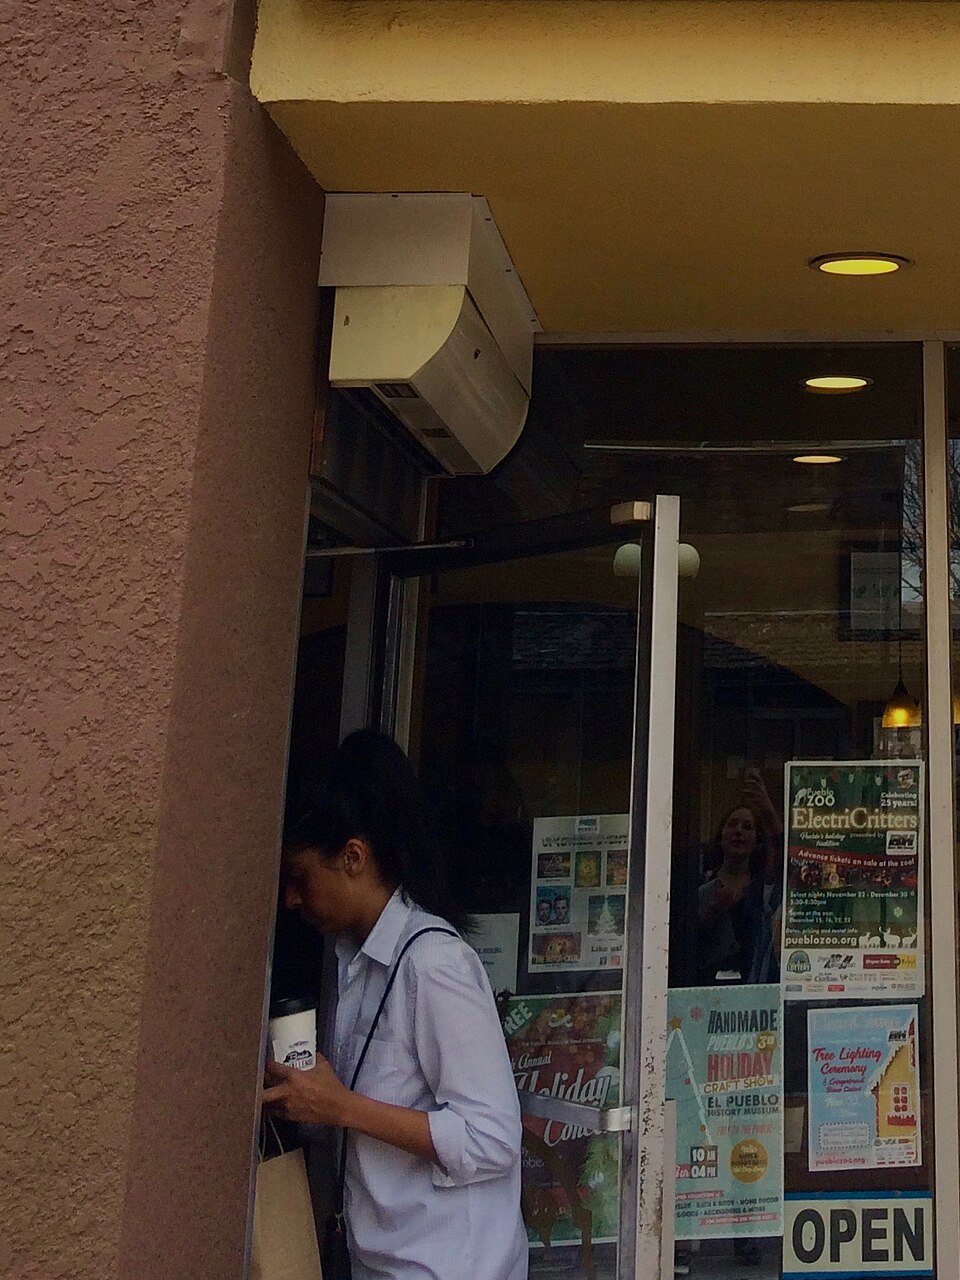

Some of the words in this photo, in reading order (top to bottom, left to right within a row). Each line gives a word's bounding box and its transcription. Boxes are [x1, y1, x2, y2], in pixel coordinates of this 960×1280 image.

[807, 788, 834, 797] Pueblo
[807, 796, 835, 807] ZOO
[792, 807, 918, 829] ElectriCritters
[798, 850, 829, 861] Advance
[829, 855, 851, 865] tickets
[863, 858, 878, 866] sale
[887, 858, 899, 867] the
[785, 935, 858, 947] pueblozoo.org
[504, 1001, 533, 1036] REE
[707, 1009, 778, 1034] HANDMADE
[812, 1047, 835, 1062] Tree
[839, 1046, 883, 1064] Lighting
[707, 1051, 774, 1082] HOLIDAY
[820, 1062, 868, 1076] Ceremony
[703, 1080, 740, 1094] CRAFT
[743, 1076, 775, 1089] SHOW
[707, 1096, 722, 1109] EL
[726, 1094, 780, 1108] PUEBLO
[707, 1107, 741, 1117] HISTORY
[743, 1106, 780, 1116] MUSEUM
[692, 1148, 705, 1162] 10
[691, 1164, 706, 1178] 04
[792, 1206, 924, 1264] OPEN
